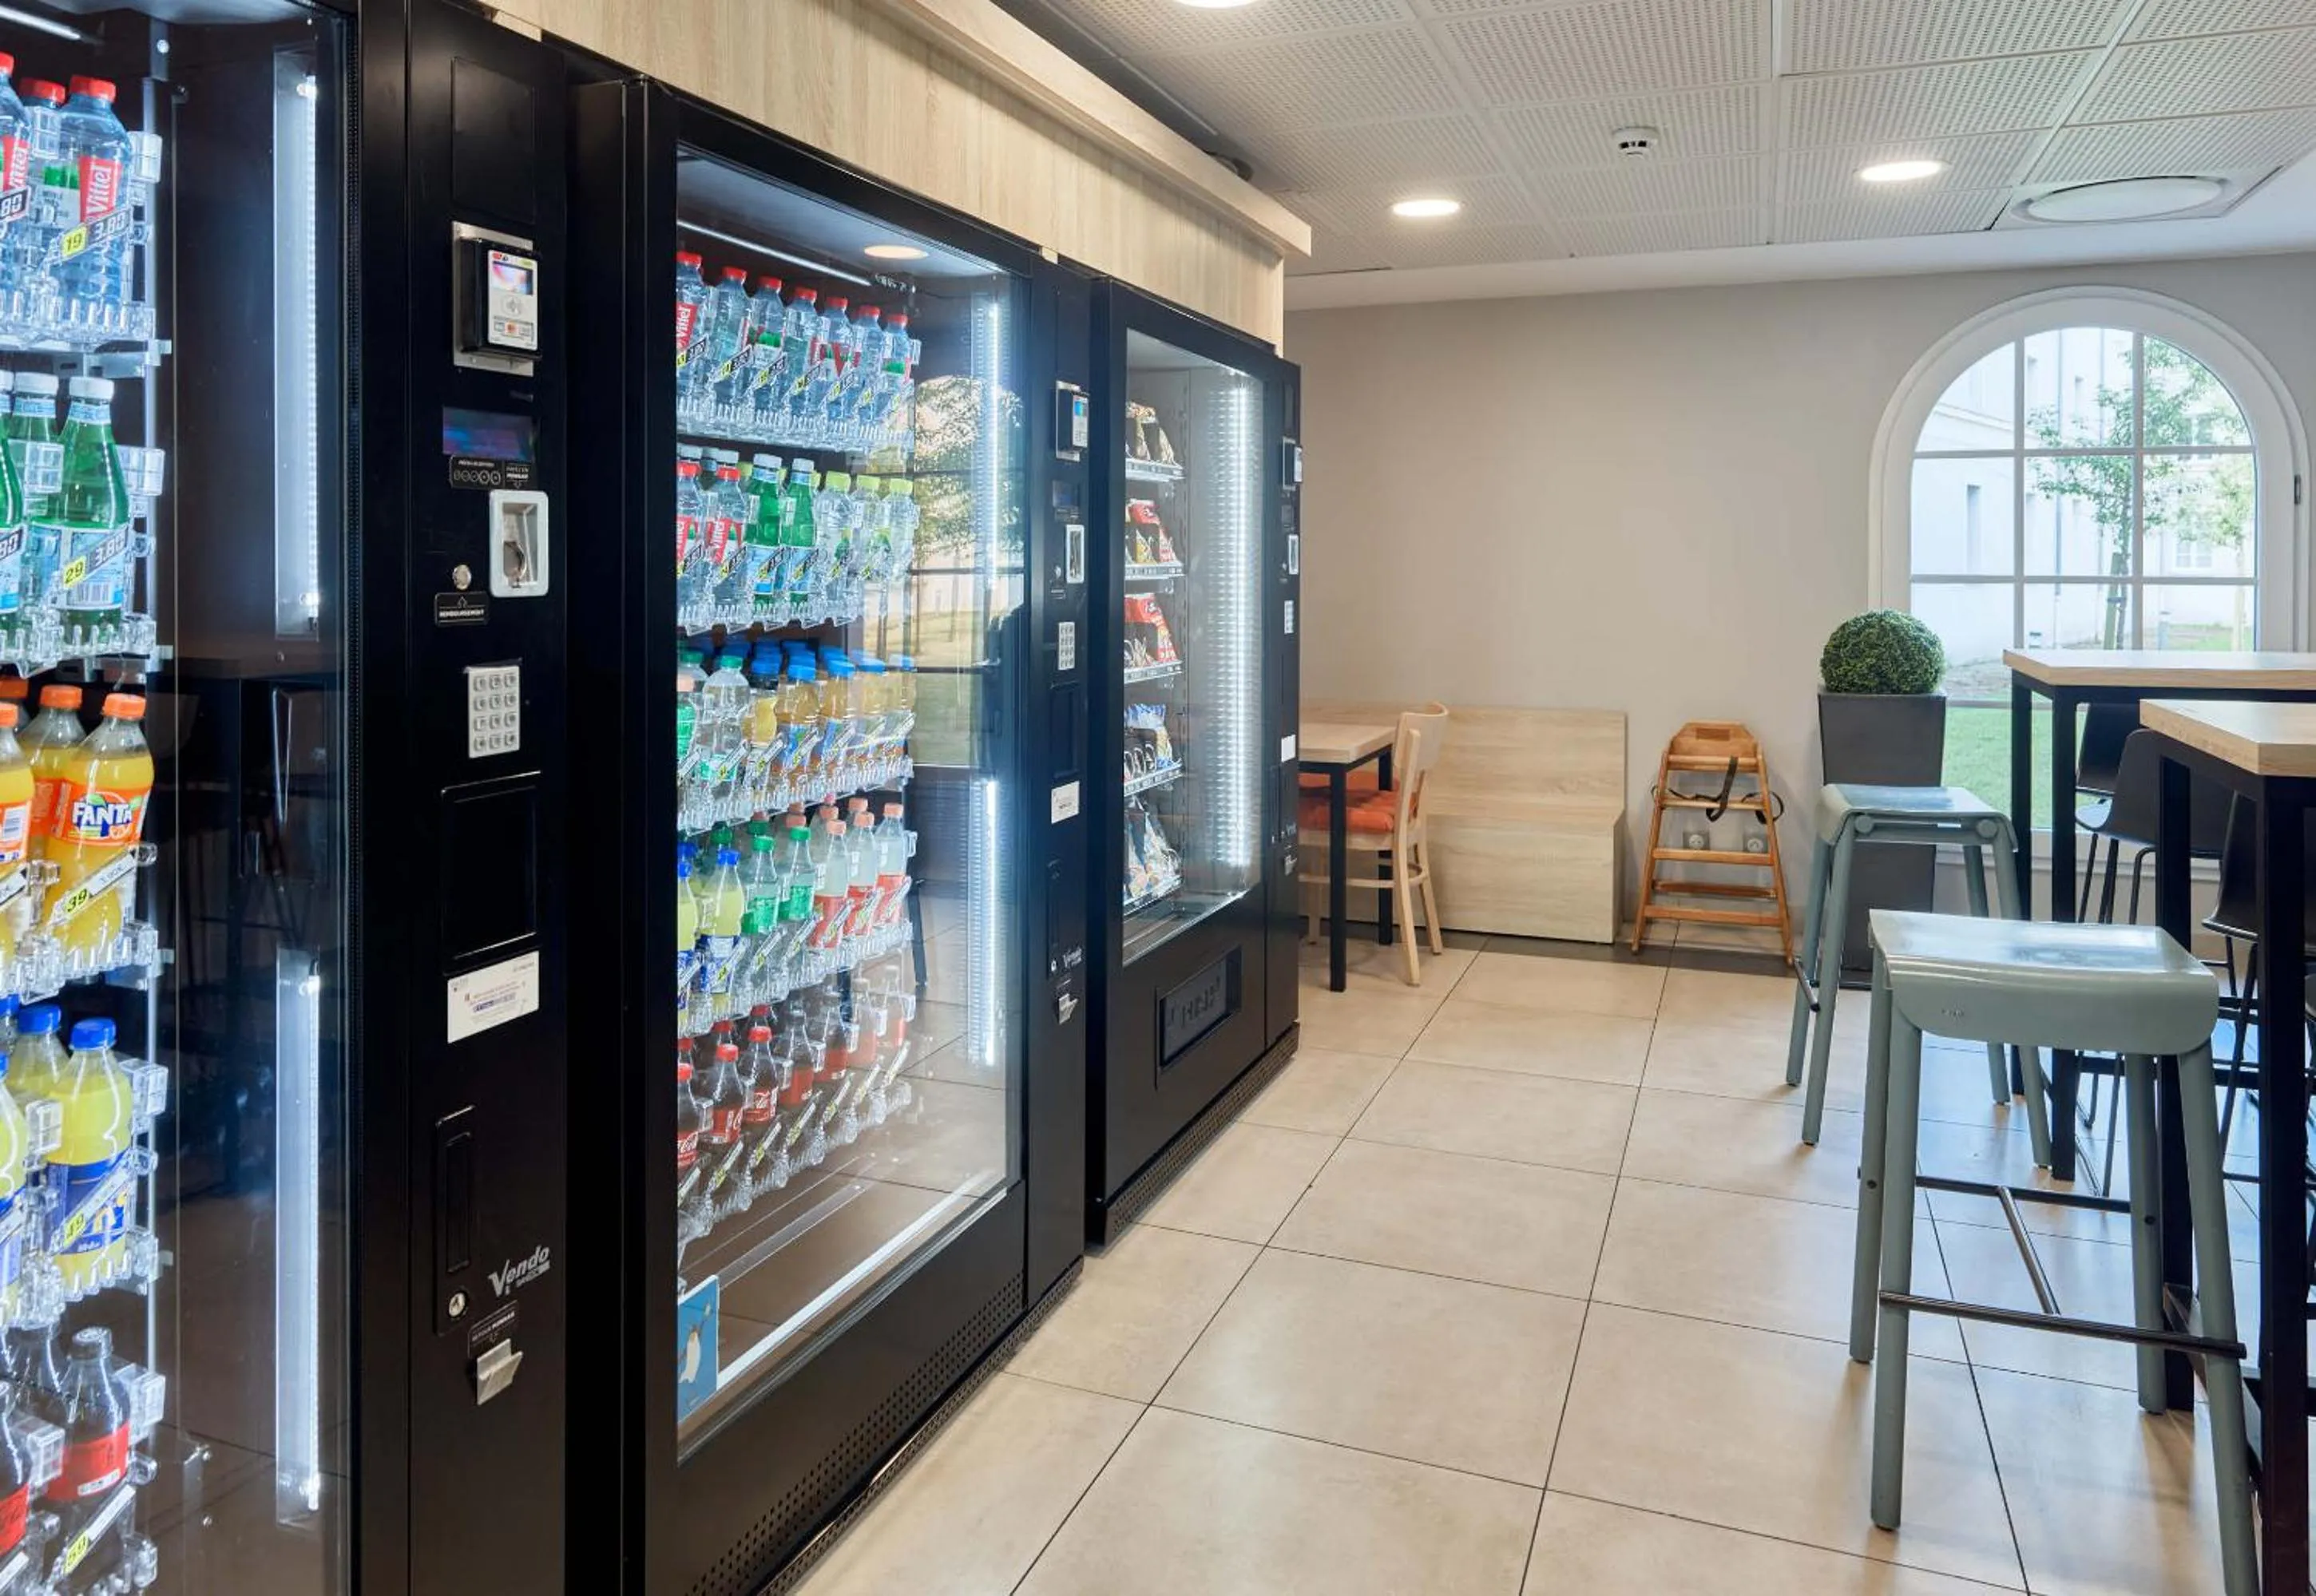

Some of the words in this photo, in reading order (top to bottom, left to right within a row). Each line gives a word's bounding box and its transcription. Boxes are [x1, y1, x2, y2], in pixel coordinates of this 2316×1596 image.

[86, 164, 112, 214] Vittel
[65, 234, 82, 251] 19
[65, 560, 84, 584] 29
[73, 802, 133, 826] FANTA
[487, 1244, 549, 1297] Vendo
